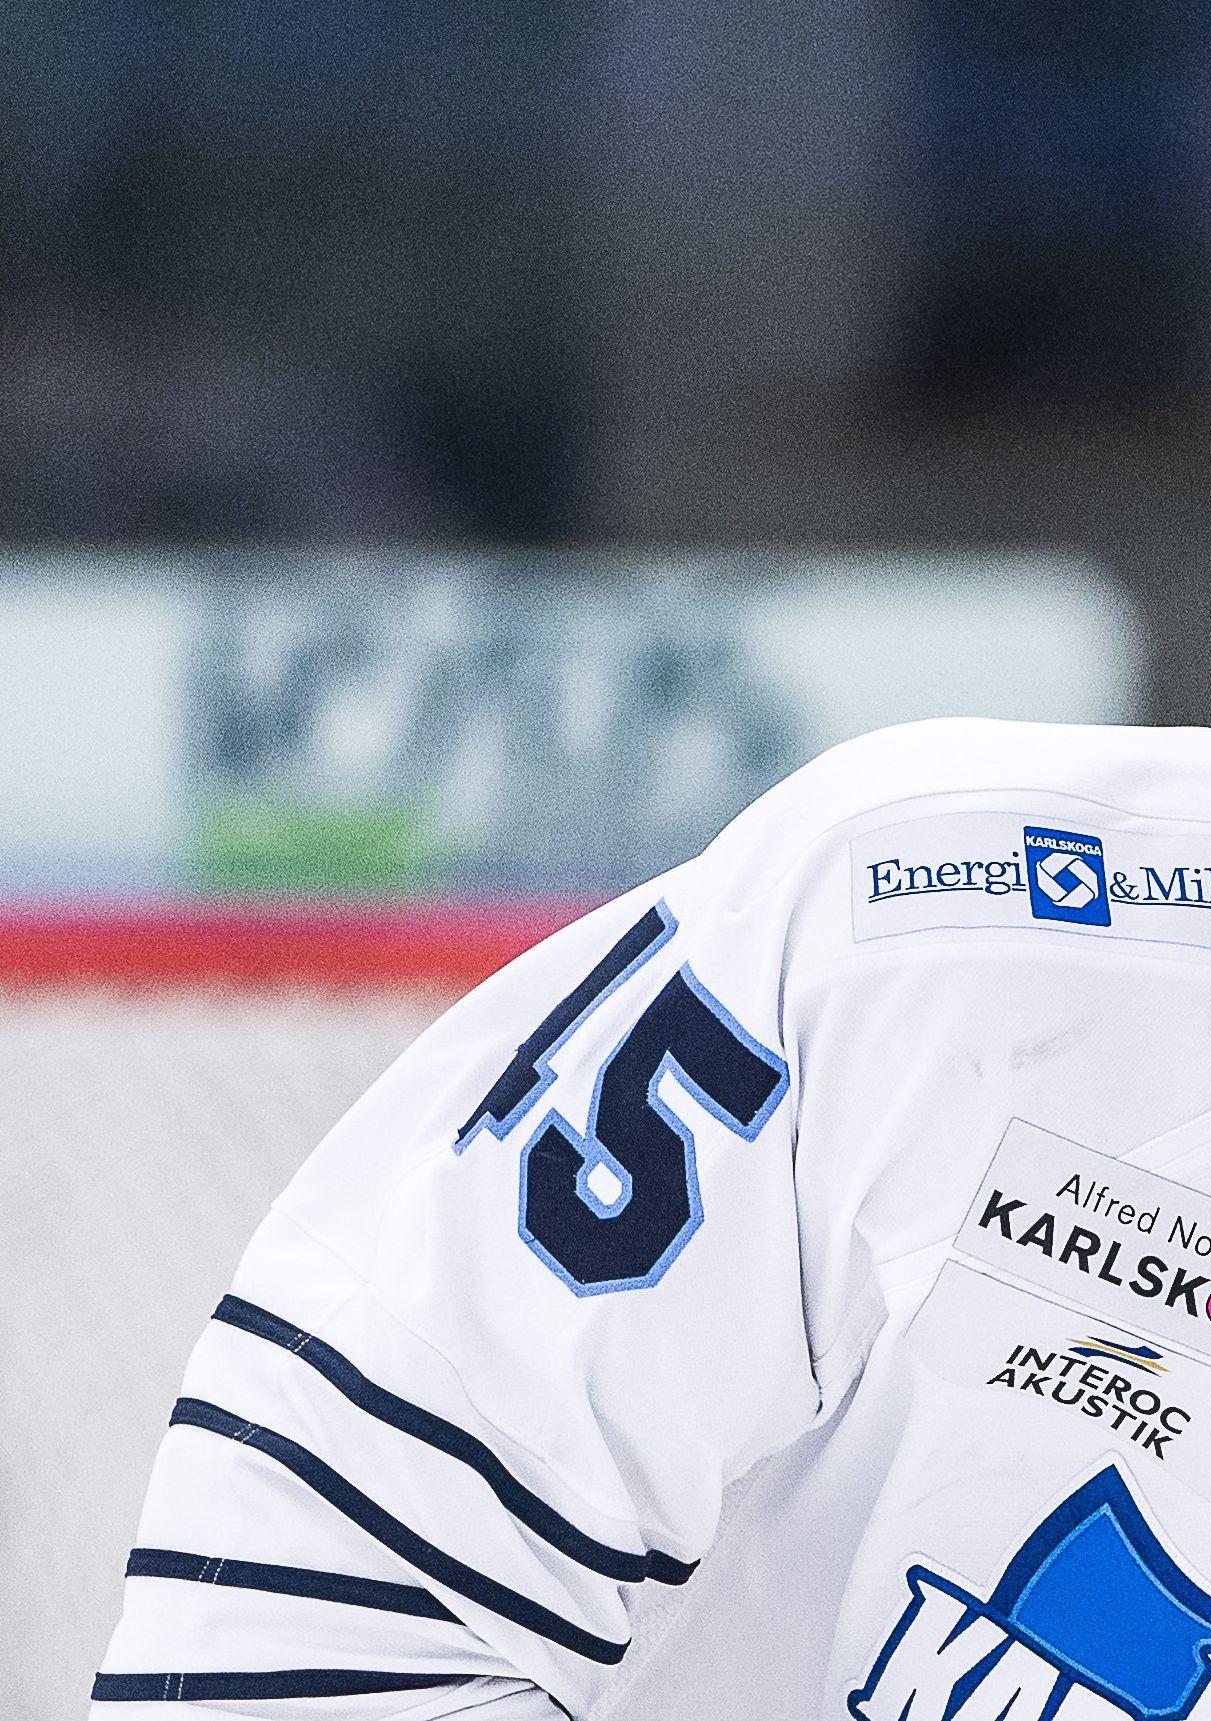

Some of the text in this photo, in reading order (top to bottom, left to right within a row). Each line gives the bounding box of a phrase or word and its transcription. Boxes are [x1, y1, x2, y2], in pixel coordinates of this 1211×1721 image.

[867, 851, 1026, 896] Energi
[1025, 835, 1102, 857] KARLSKOGA
[1055, 1172, 1161, 1236] Alfred
[986, 1367, 1175, 1462] AKUSTIK
[1004, 1344, 1193, 1436] INTEROC
